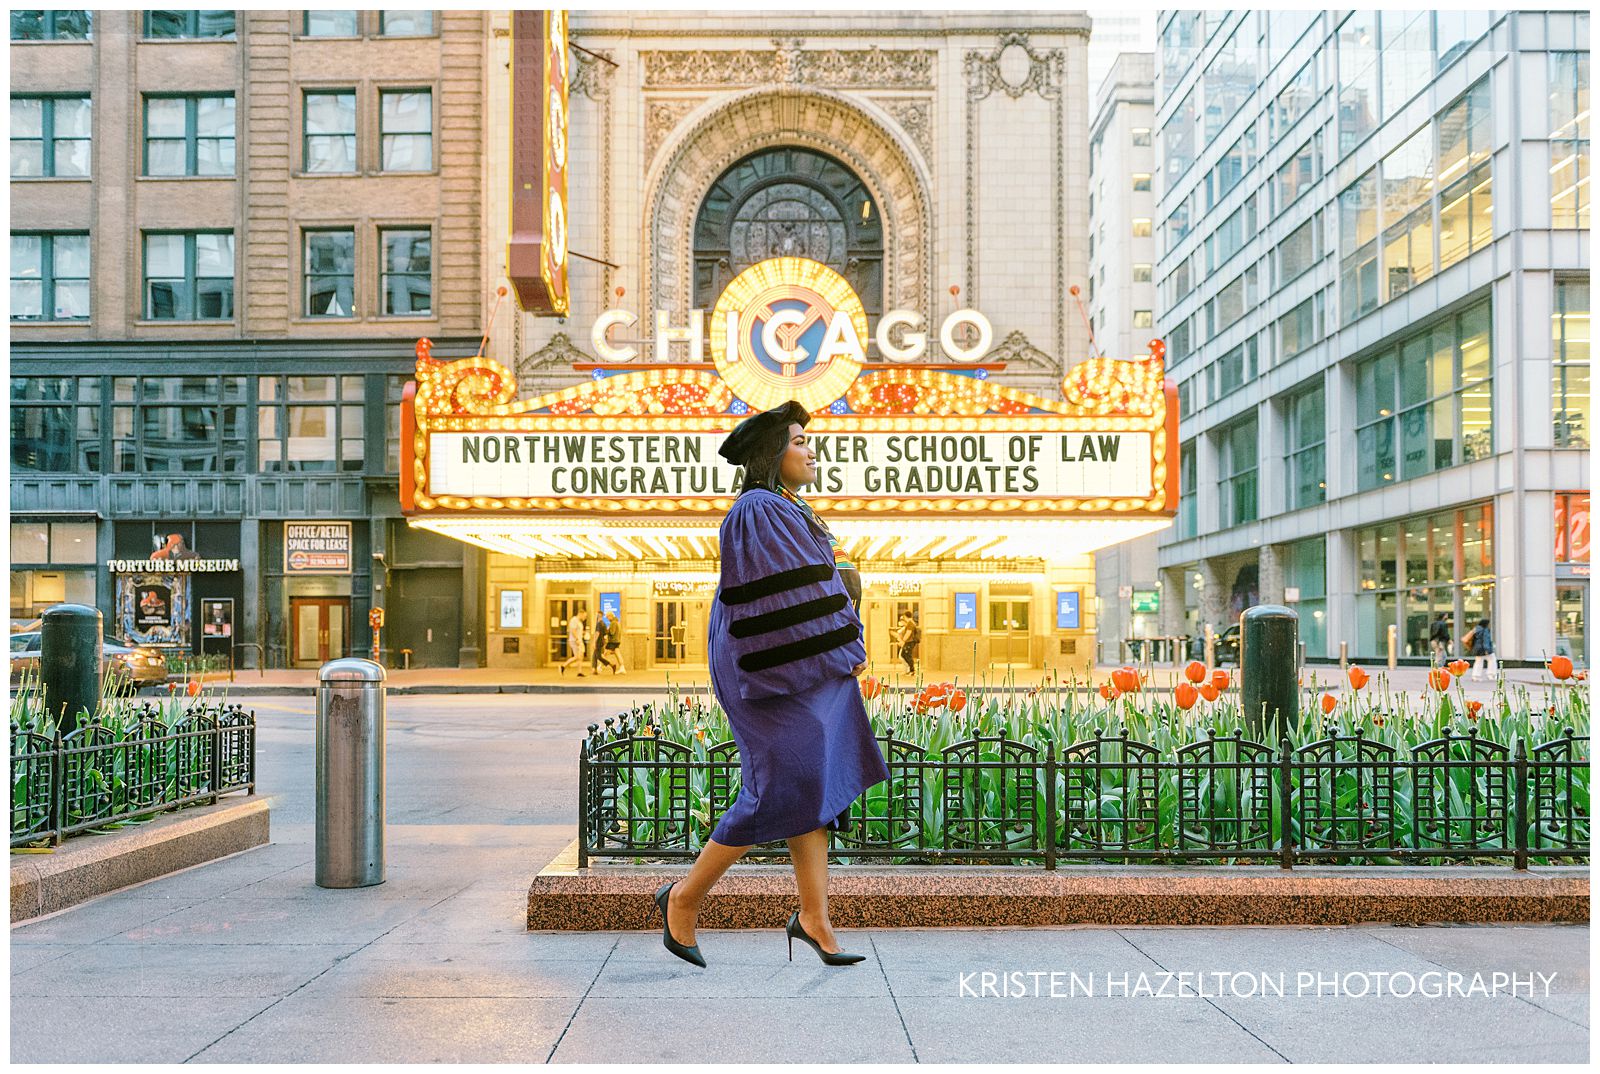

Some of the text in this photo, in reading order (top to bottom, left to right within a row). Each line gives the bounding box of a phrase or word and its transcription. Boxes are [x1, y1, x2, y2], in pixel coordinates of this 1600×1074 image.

[591, 308, 993, 364] CHICAGO
[462, 435, 1121, 463] NORTHWESTERN KER SCHOOL OF LAW
[864, 465, 1039, 493] GRADUATES
[288, 525, 348, 538] OFFICE/RETAIL
[288, 539, 348, 550] SPACE FOR LEASE
[106, 559, 240, 572] TORTURE MUSEUM
